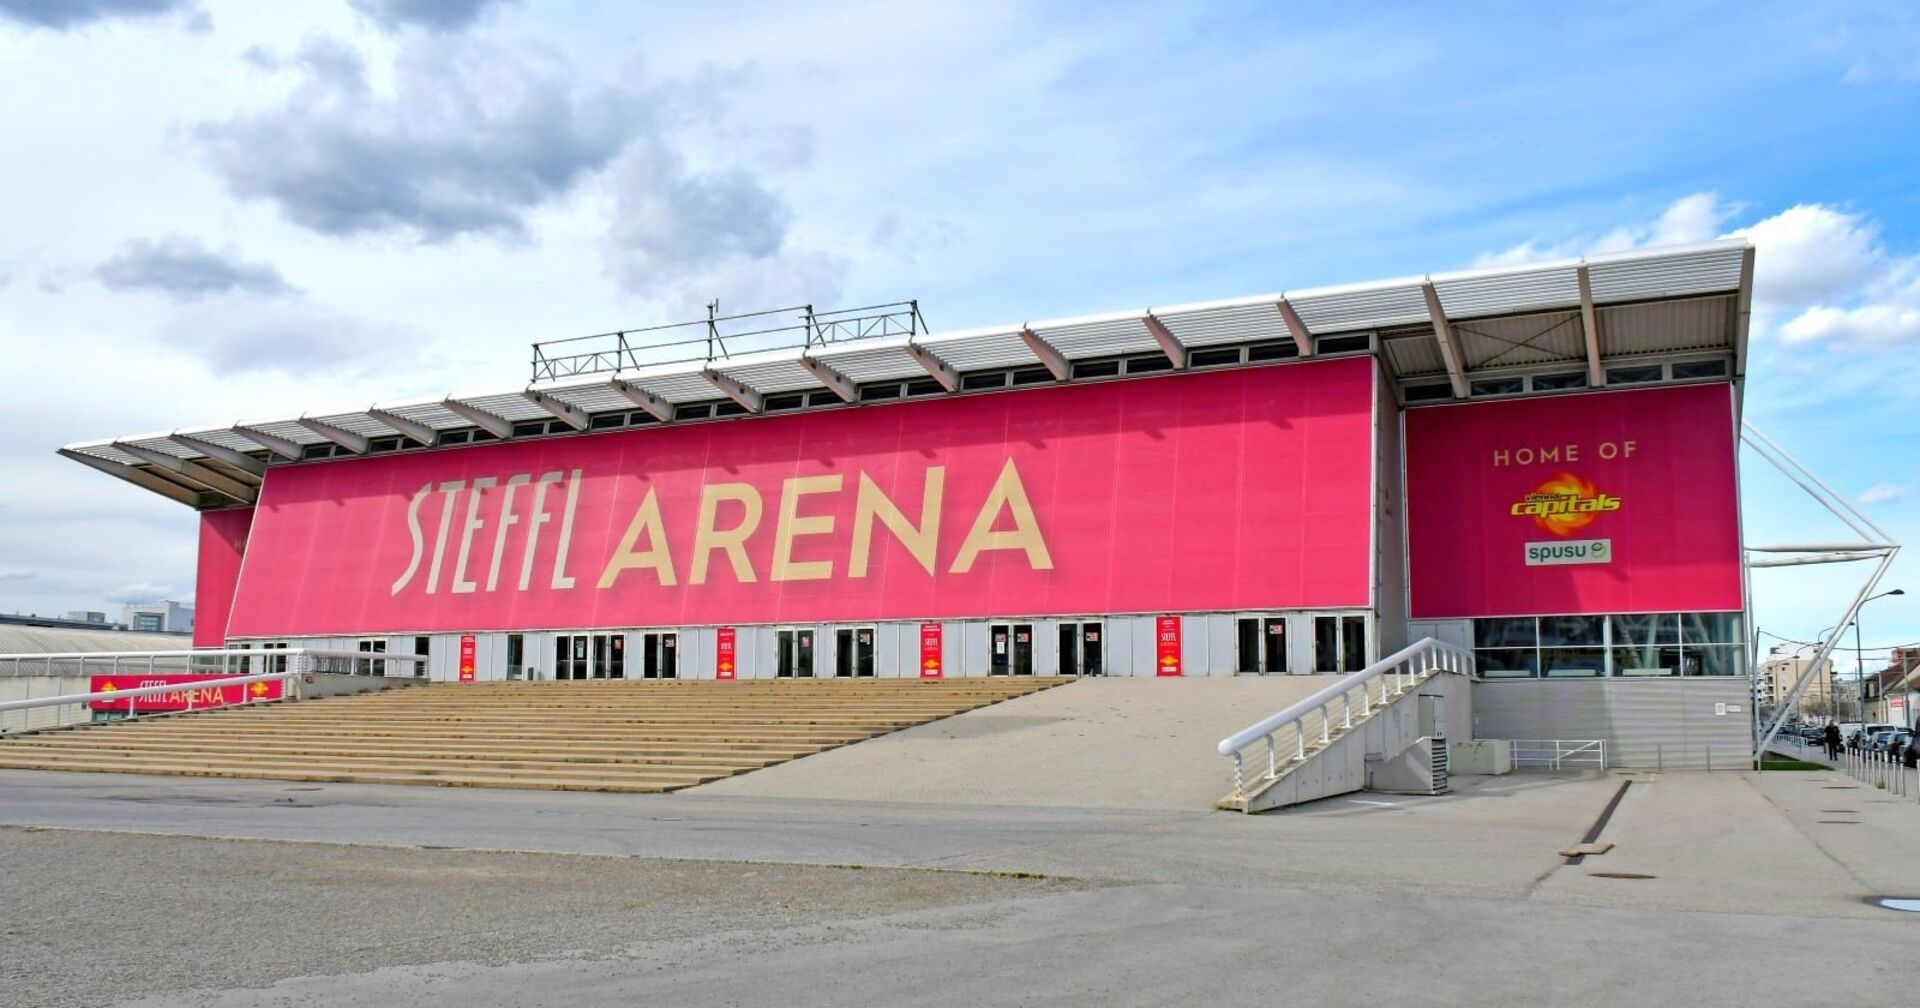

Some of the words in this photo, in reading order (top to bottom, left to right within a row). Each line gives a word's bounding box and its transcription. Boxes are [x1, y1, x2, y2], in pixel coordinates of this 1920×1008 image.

[1493, 444, 1579, 467] HOME
[1598, 440, 1637, 460] OF
[1510, 493, 1622, 518] capitals
[391, 467, 583, 597] STEFFL
[596, 456, 1054, 589] ARENA
[1528, 545, 1586, 562] spusu
